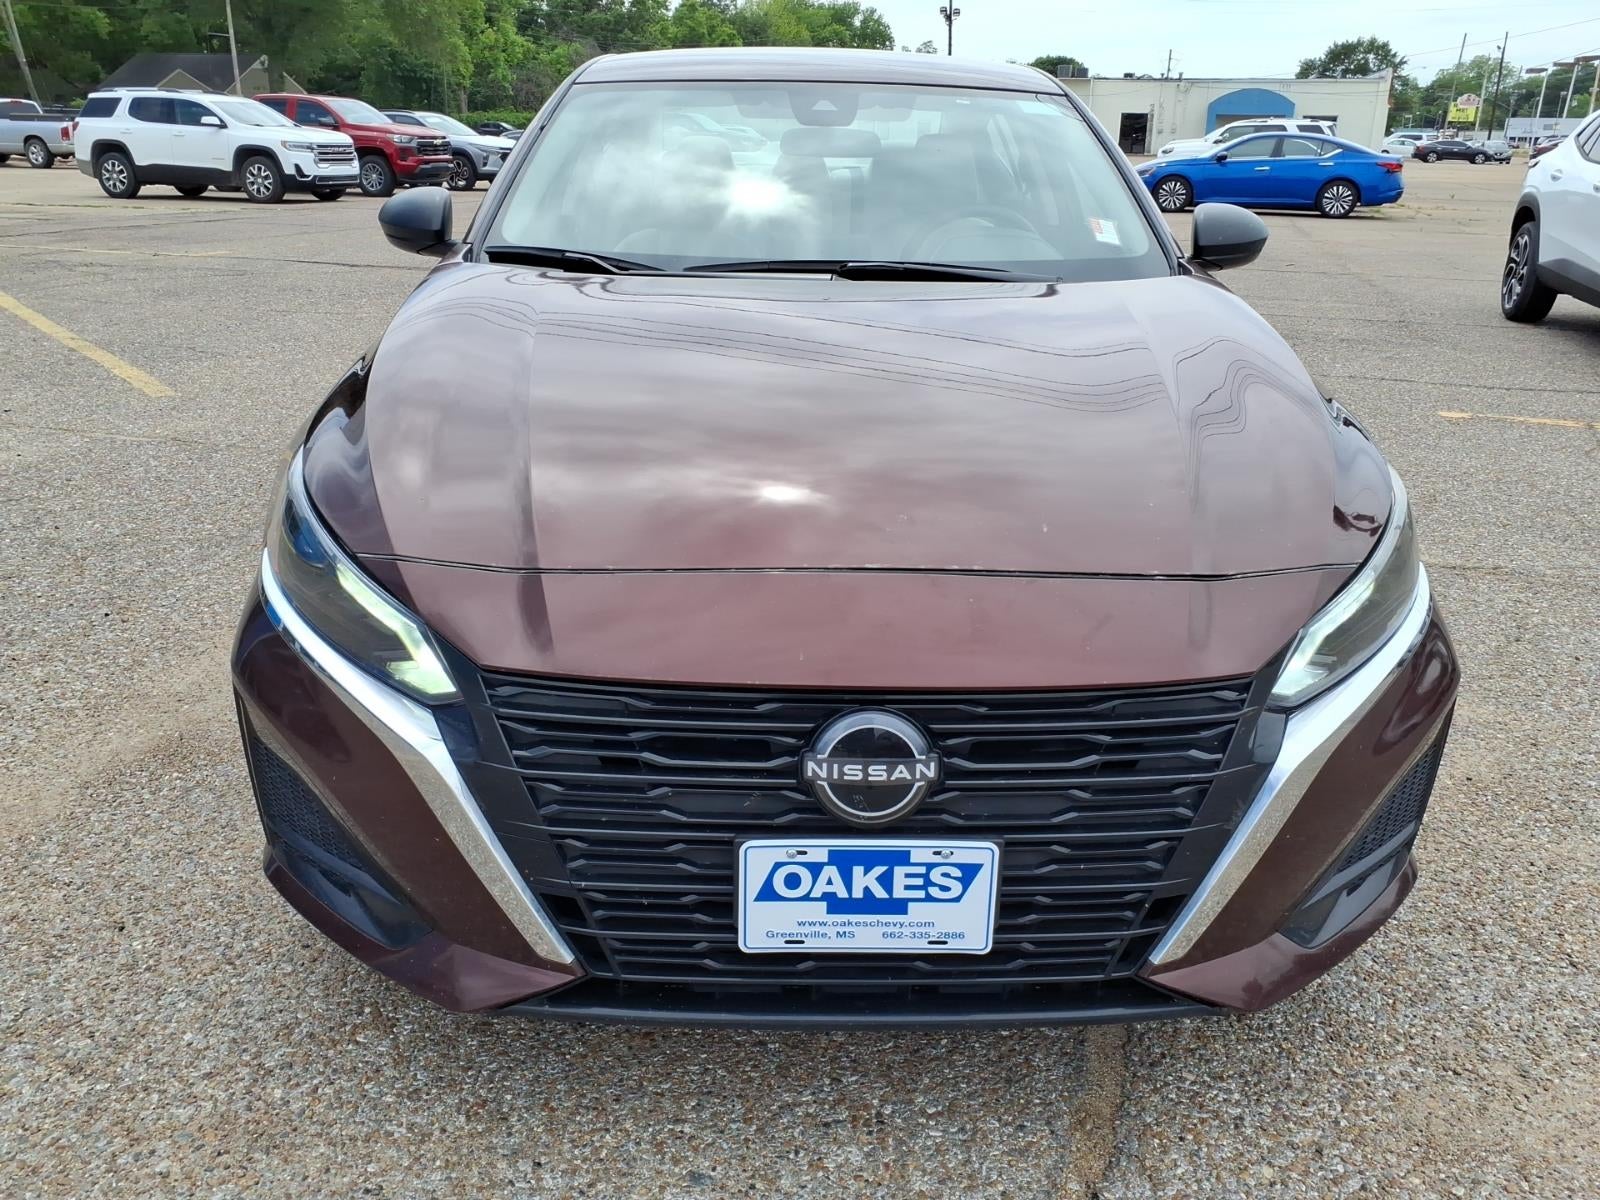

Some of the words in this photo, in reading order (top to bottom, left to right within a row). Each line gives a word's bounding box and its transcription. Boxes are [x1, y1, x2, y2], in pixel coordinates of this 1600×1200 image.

[806, 760, 935, 781] NISSAN
[772, 864, 963, 899] OAKES
[797, 919, 935, 929] www.oakeschevy.com
[766, 930, 832, 940] Greenville,
[836, 930, 856, 939] MS
[882, 931, 965, 940] 662-335-2886
